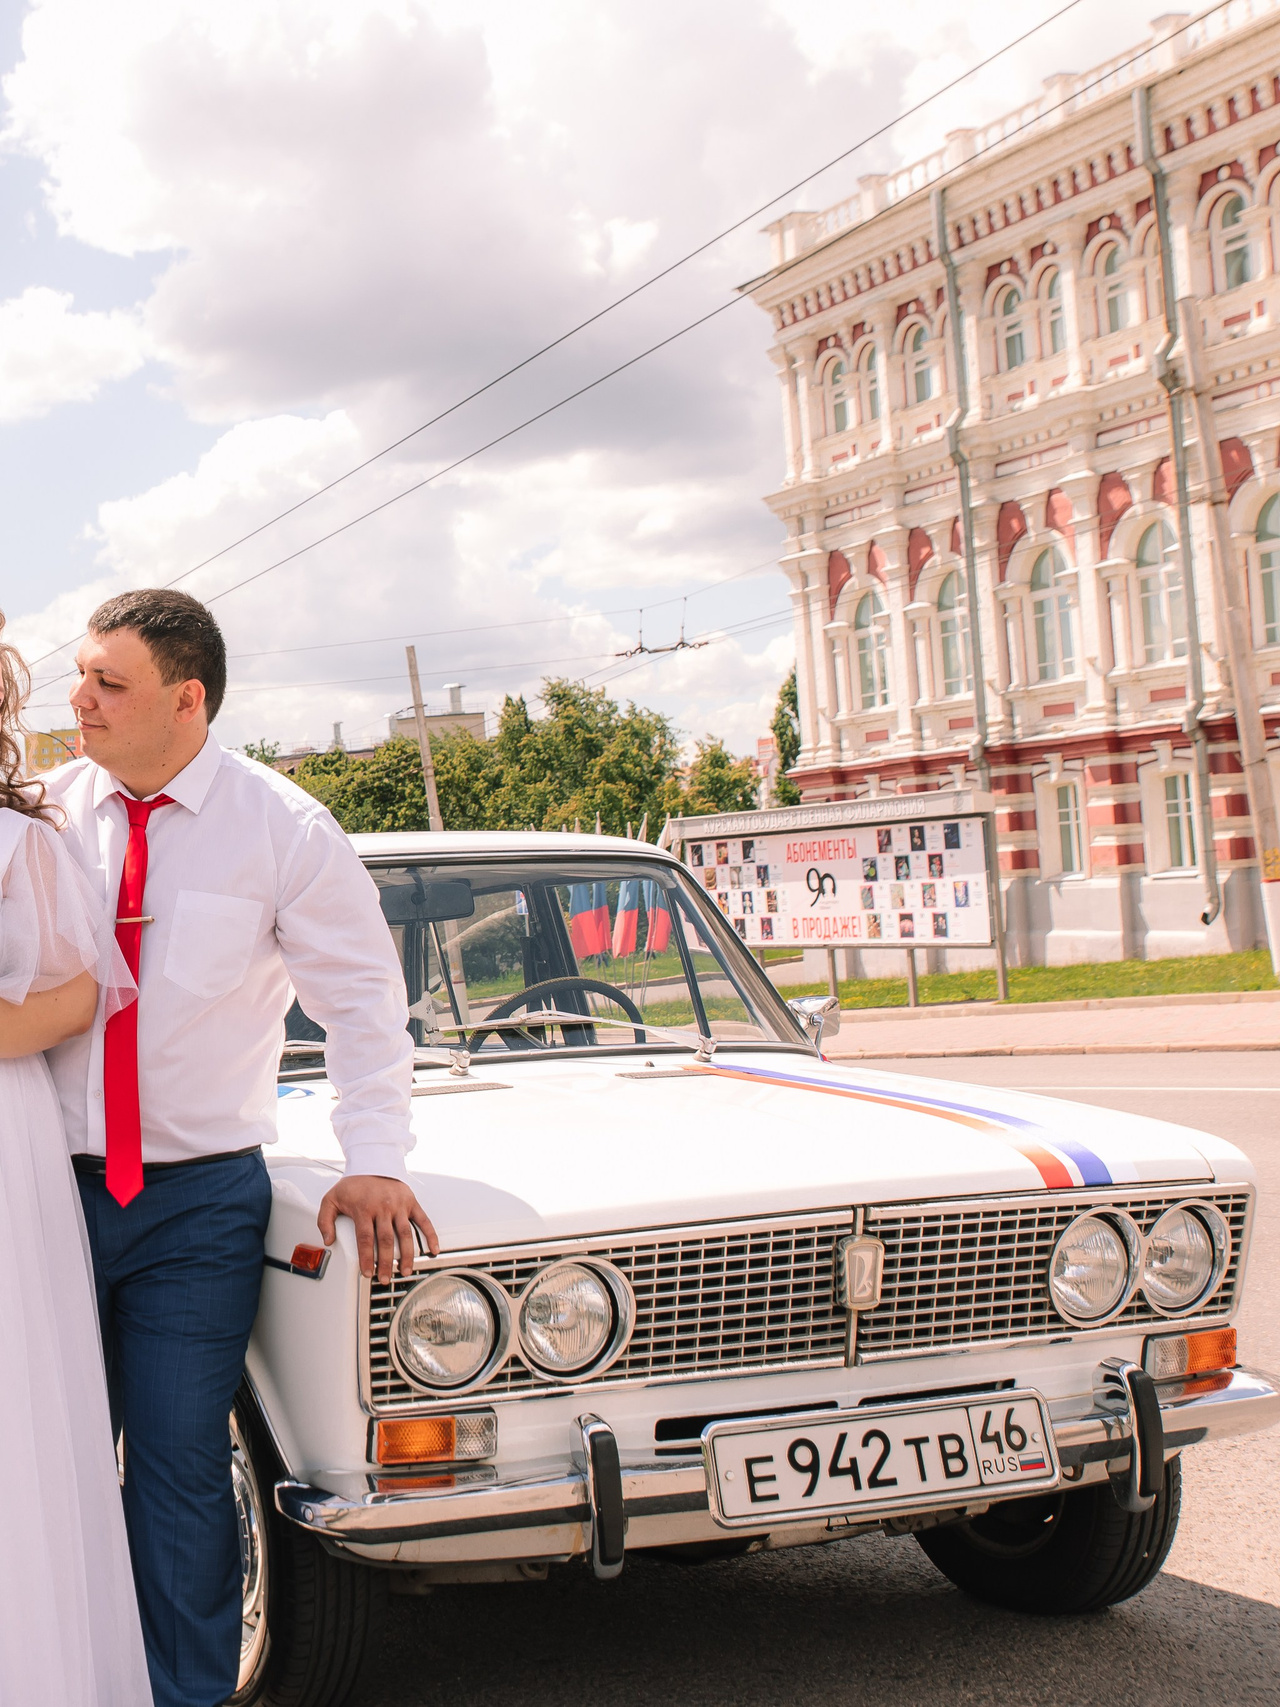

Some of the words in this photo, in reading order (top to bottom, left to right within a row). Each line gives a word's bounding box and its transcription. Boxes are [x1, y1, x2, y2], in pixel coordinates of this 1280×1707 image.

[703, 816, 745, 834] КУРСКАЯ
[746, 806, 843, 832] ГОСУДАРСТВЕННАЯ
[844, 798, 926, 821] ФИЛАРМОНИЯ
[786, 838, 857, 863] АБОНЕМЕНТЫ
[792, 917, 800, 939] В
[802, 915, 862, 940] ПРОДАЖЕ!
[980, 1407, 1028, 1454] 46
[982, 1456, 1019, 1475] RUS
